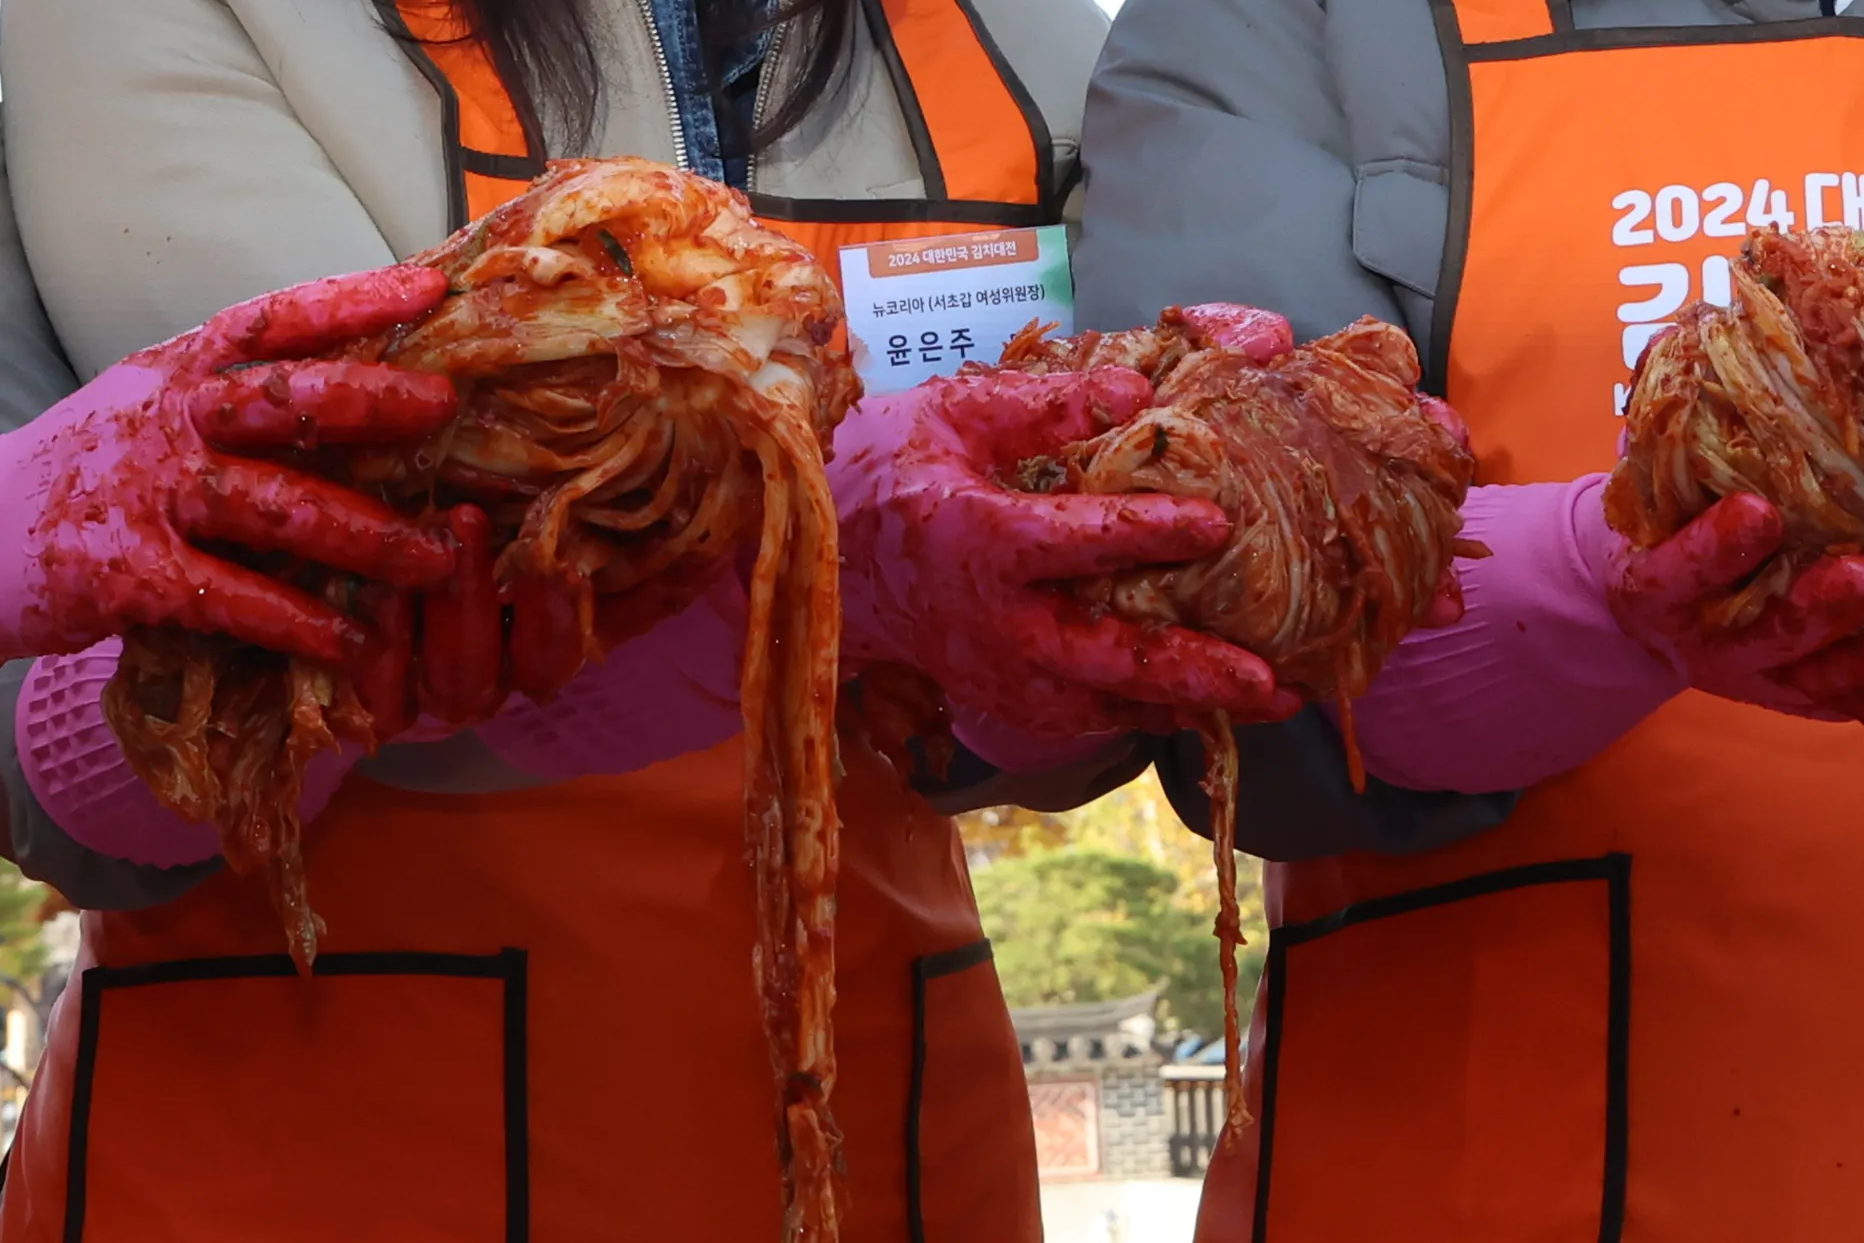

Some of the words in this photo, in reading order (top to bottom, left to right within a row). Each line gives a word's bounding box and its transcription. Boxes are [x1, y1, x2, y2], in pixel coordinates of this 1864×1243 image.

[1611, 178, 1794, 247] 2024
[888, 250, 920, 268] 2024
[922, 244, 969, 265] 대한민국
[971, 240, 1017, 260] 김치대전
[872, 297, 925, 318] 뉴코리아
[928, 293, 972, 312] (서초갑
[975, 284, 1046, 308] 여성위원장)
[886, 327, 976, 367] 윤은주
